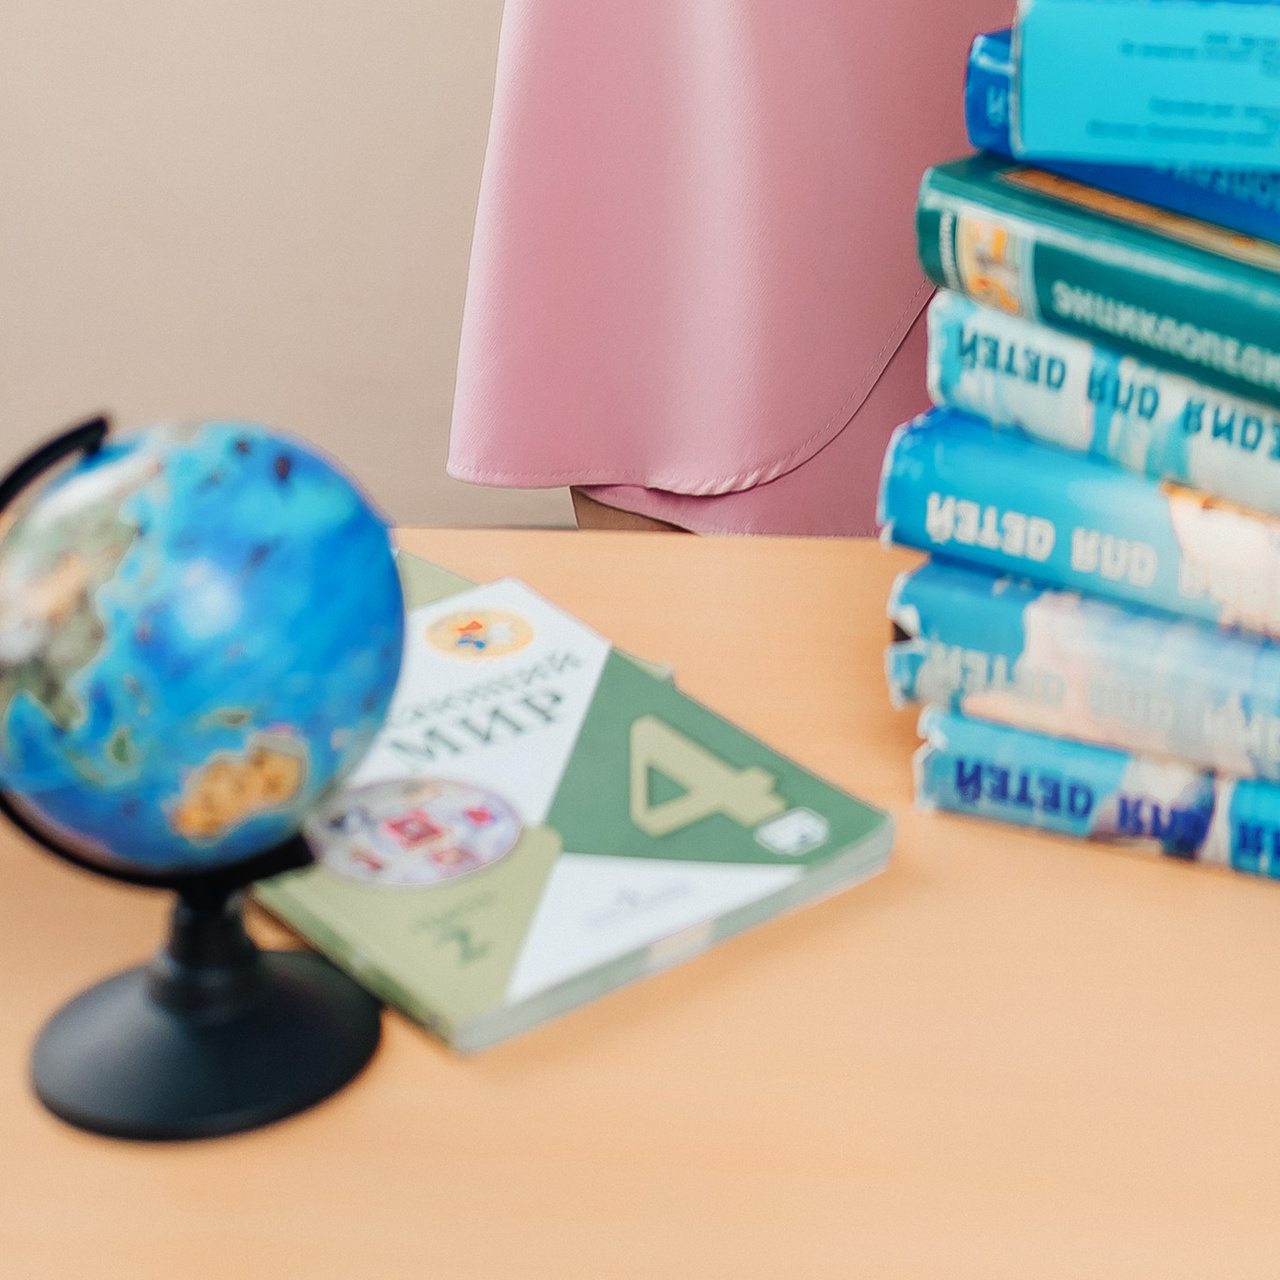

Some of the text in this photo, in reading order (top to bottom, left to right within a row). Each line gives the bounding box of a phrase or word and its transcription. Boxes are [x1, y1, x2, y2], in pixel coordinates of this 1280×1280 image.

[956, 322, 1067, 390] ДЕТЕЙ
[1086, 364, 1161, 422] ДЛЯ
[924, 490, 1057, 564] ДЕТЕЙ
[1070, 525, 1159, 590] ДЛЯ
[388, 691, 563, 762] МИР
[630, 713, 789, 837] 4
[954, 756, 1095, 820] ДЕТЕЙ
